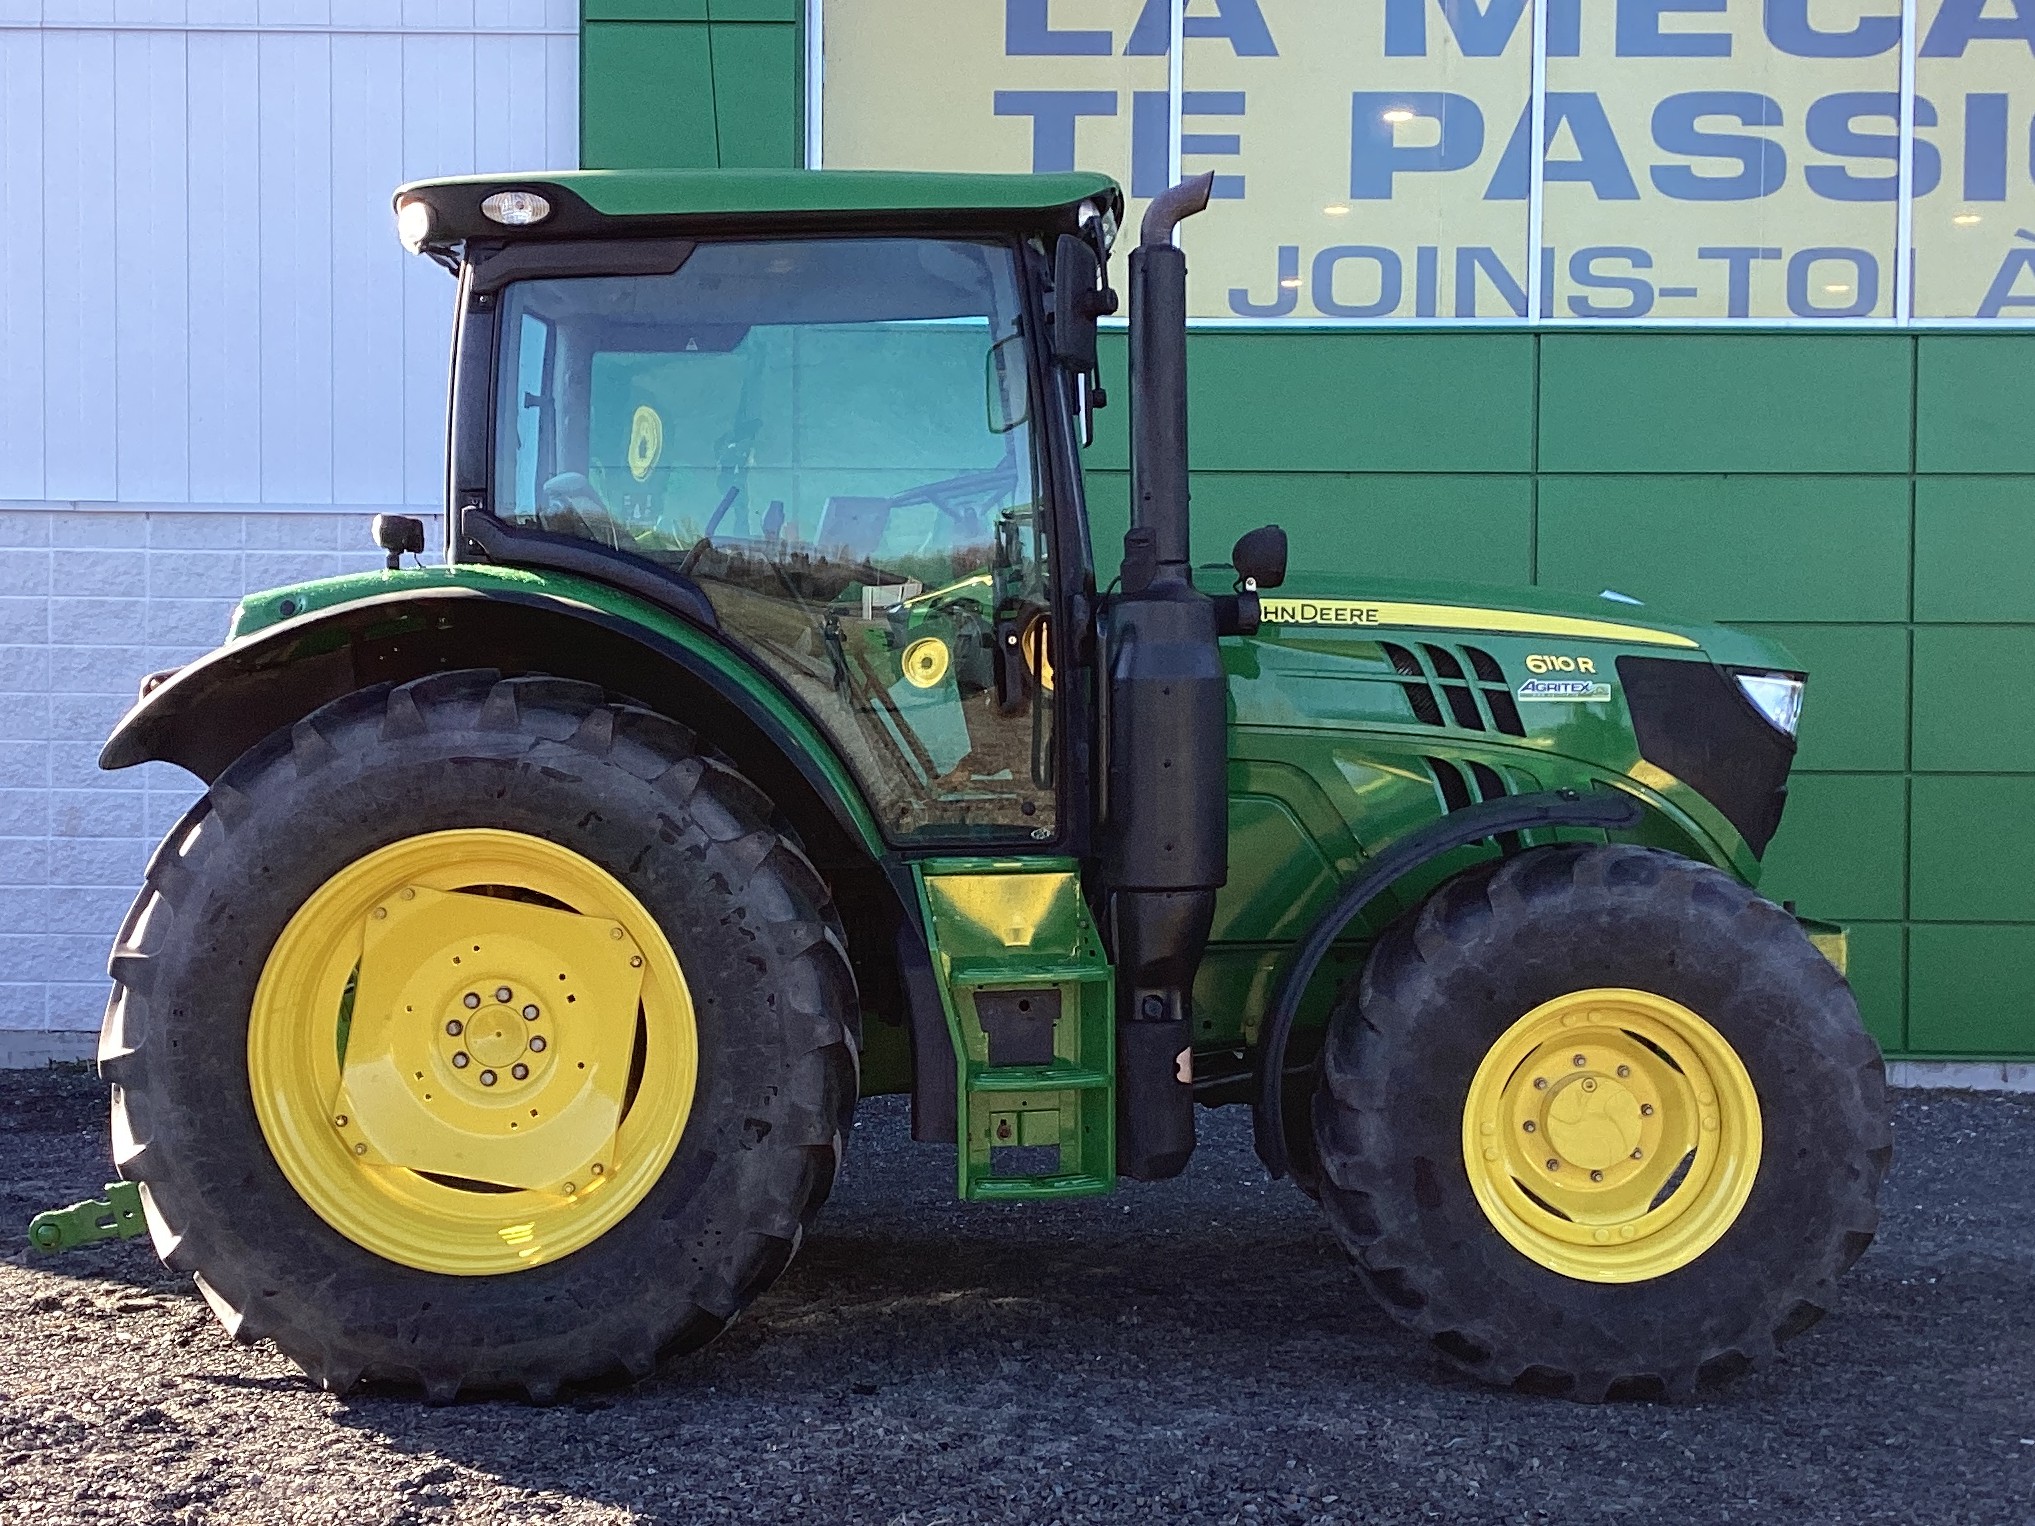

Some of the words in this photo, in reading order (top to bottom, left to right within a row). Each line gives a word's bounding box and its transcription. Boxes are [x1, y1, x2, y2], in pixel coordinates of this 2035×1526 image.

[1006, 0, 1280, 57] LA
[994, 91, 1246, 199] TE
[1350, 91, 2035, 202] PASSI
[1262, 606, 1296, 620] HN
[1301, 603, 1379, 622] DEERE
[1520, 680, 1590, 692] AGRITEX
